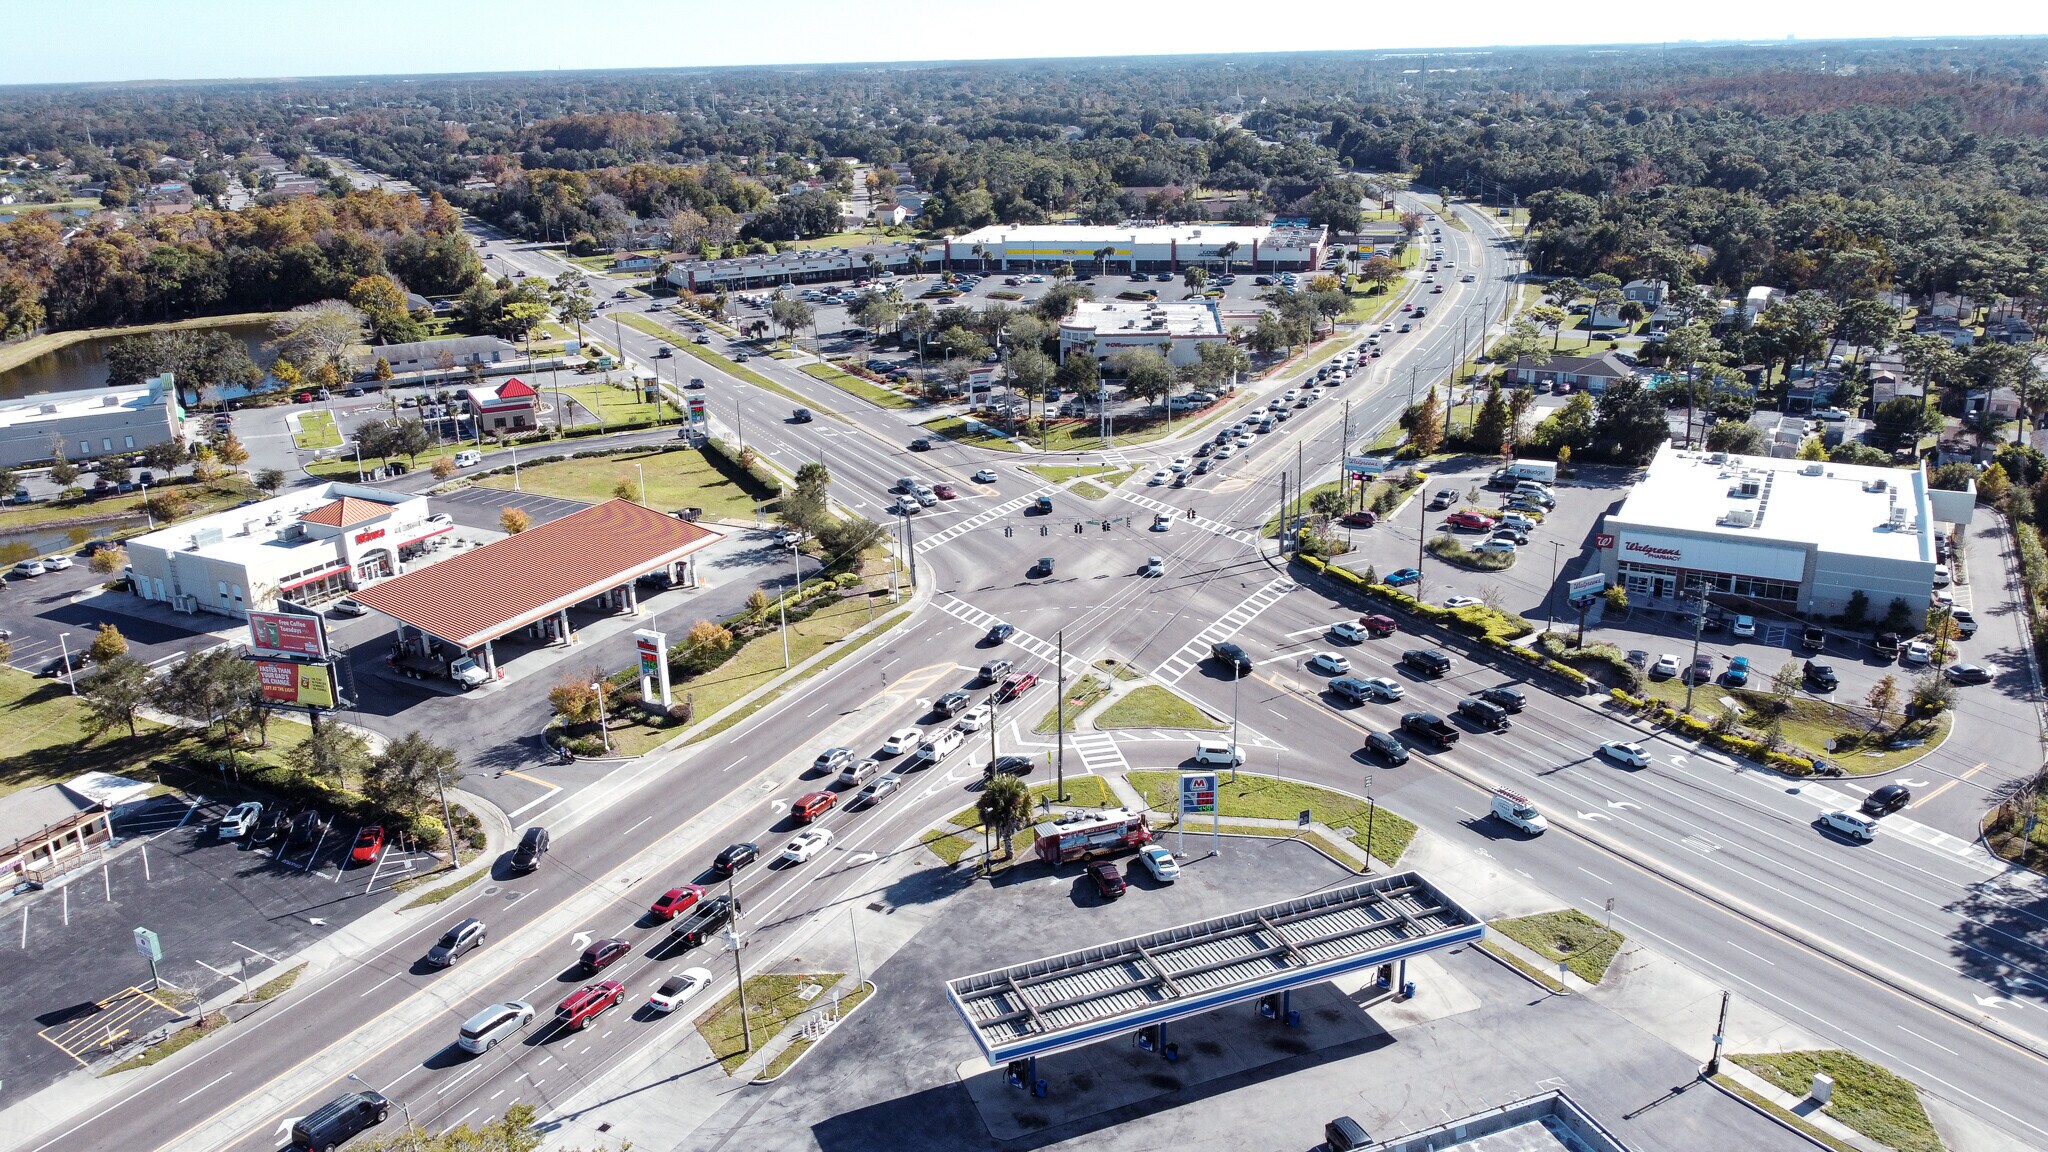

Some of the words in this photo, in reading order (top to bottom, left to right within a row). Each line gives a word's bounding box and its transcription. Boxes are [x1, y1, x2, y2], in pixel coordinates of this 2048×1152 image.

[1349, 458, 1378, 466] Walgreens
[1526, 469, 1546, 477] Budget
[1596, 536, 1612, 546] W
[1625, 541, 1681, 557] Walgreens
[1648, 553, 1681, 561] PHARMACY
[1573, 578, 1602, 589] Walgreens
